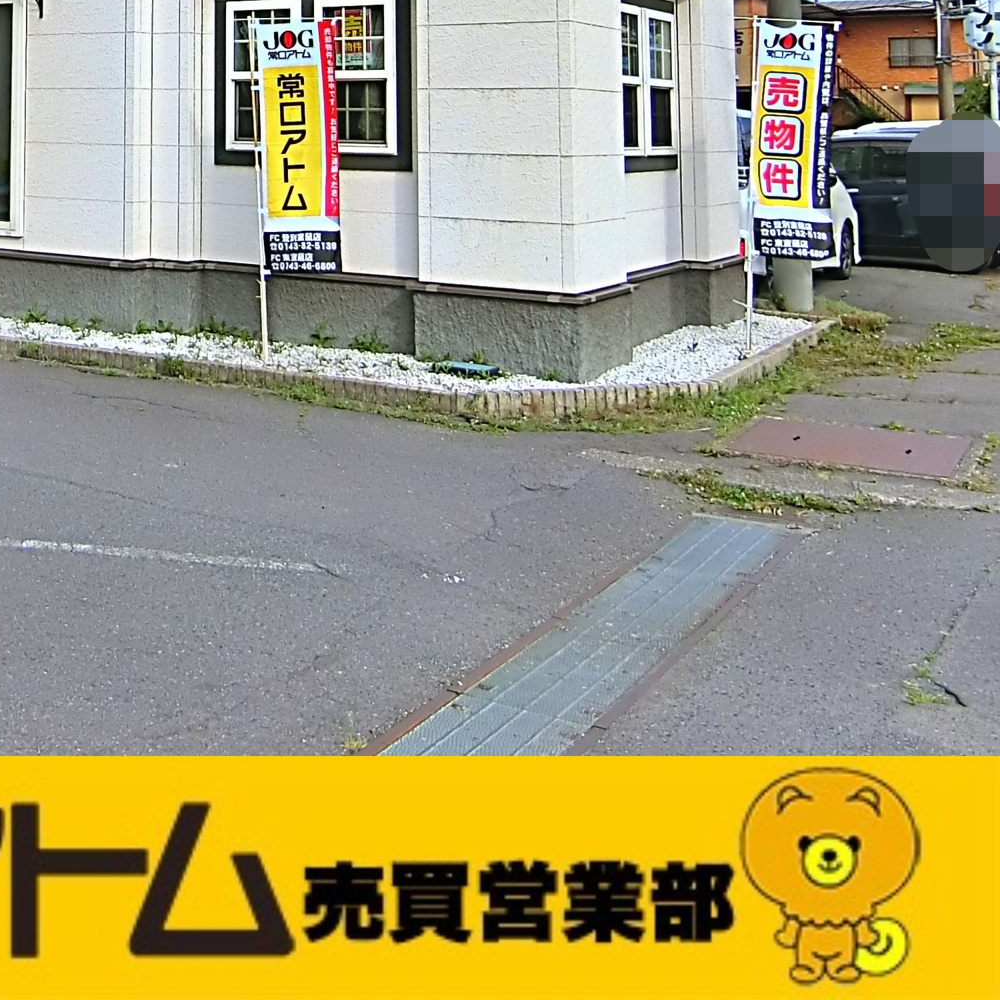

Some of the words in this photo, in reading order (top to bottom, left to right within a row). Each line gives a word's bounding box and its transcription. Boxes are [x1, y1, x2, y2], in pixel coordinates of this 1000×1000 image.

[263, 29, 314, 50] JOG
[764, 33, 815, 51] JOG
[763, 77, 800, 193] 売物件
[270, 254, 281, 262] FC
